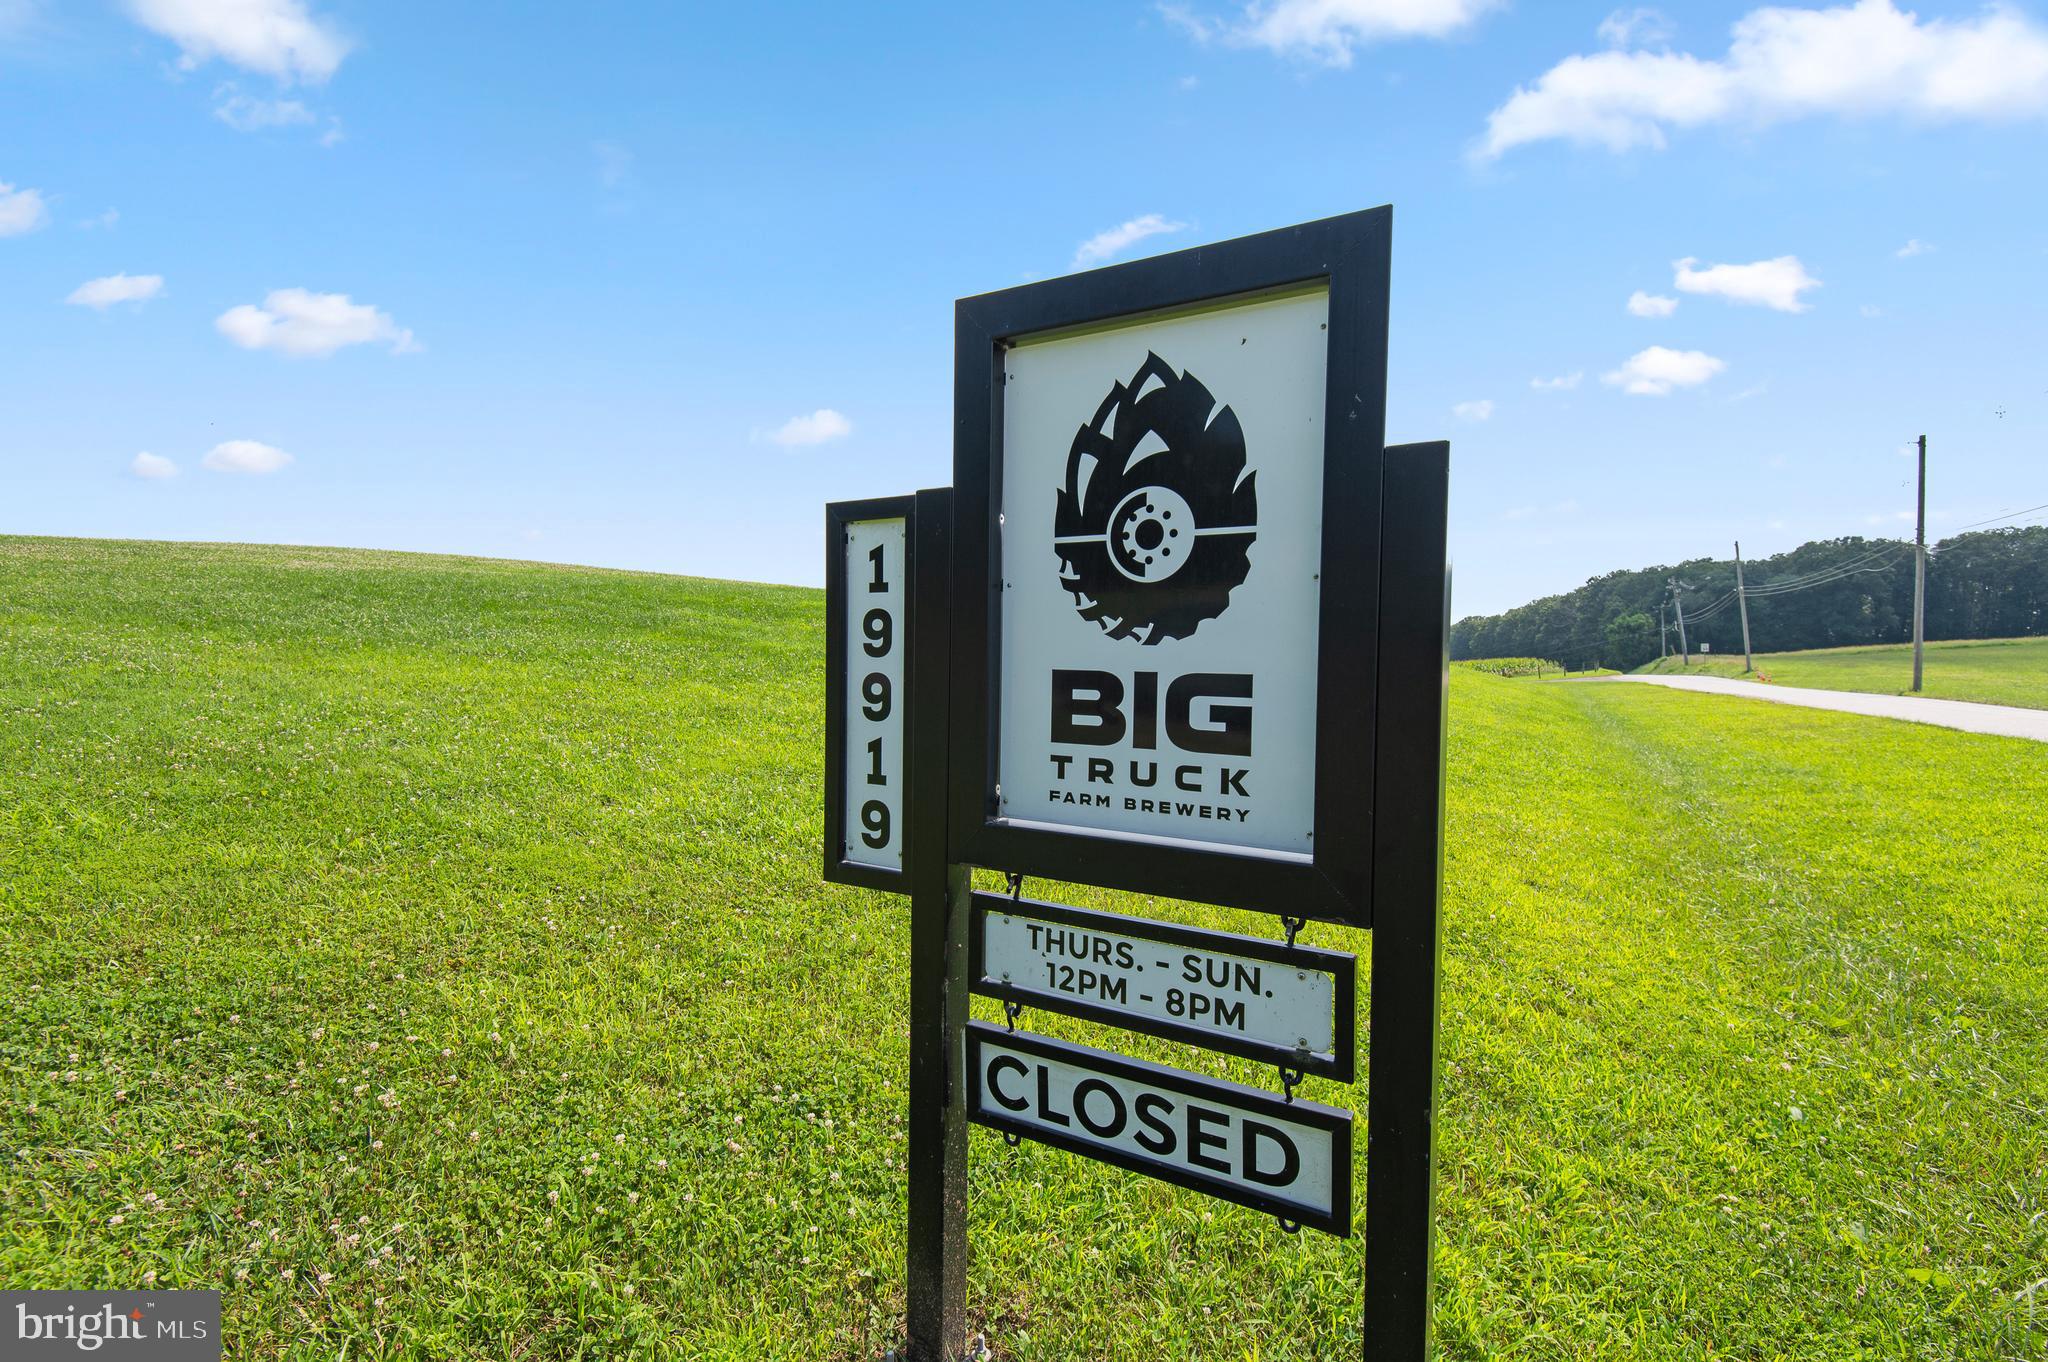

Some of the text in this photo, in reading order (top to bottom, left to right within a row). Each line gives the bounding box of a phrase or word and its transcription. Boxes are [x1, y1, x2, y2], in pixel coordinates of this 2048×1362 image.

[861, 543, 893, 850] 19919
[1050, 669, 1253, 757] BIG
[1049, 755, 1250, 797] TRUCK
[1049, 790, 1251, 823] FARM BREWERY
[1026, 924, 1144, 972] THURS.
[1182, 955, 1273, 999] SUN.
[1046, 962, 1127, 1004] 12PM
[1166, 988, 1245, 1031] 8PM
[986, 1055, 1301, 1187] CLOSED
